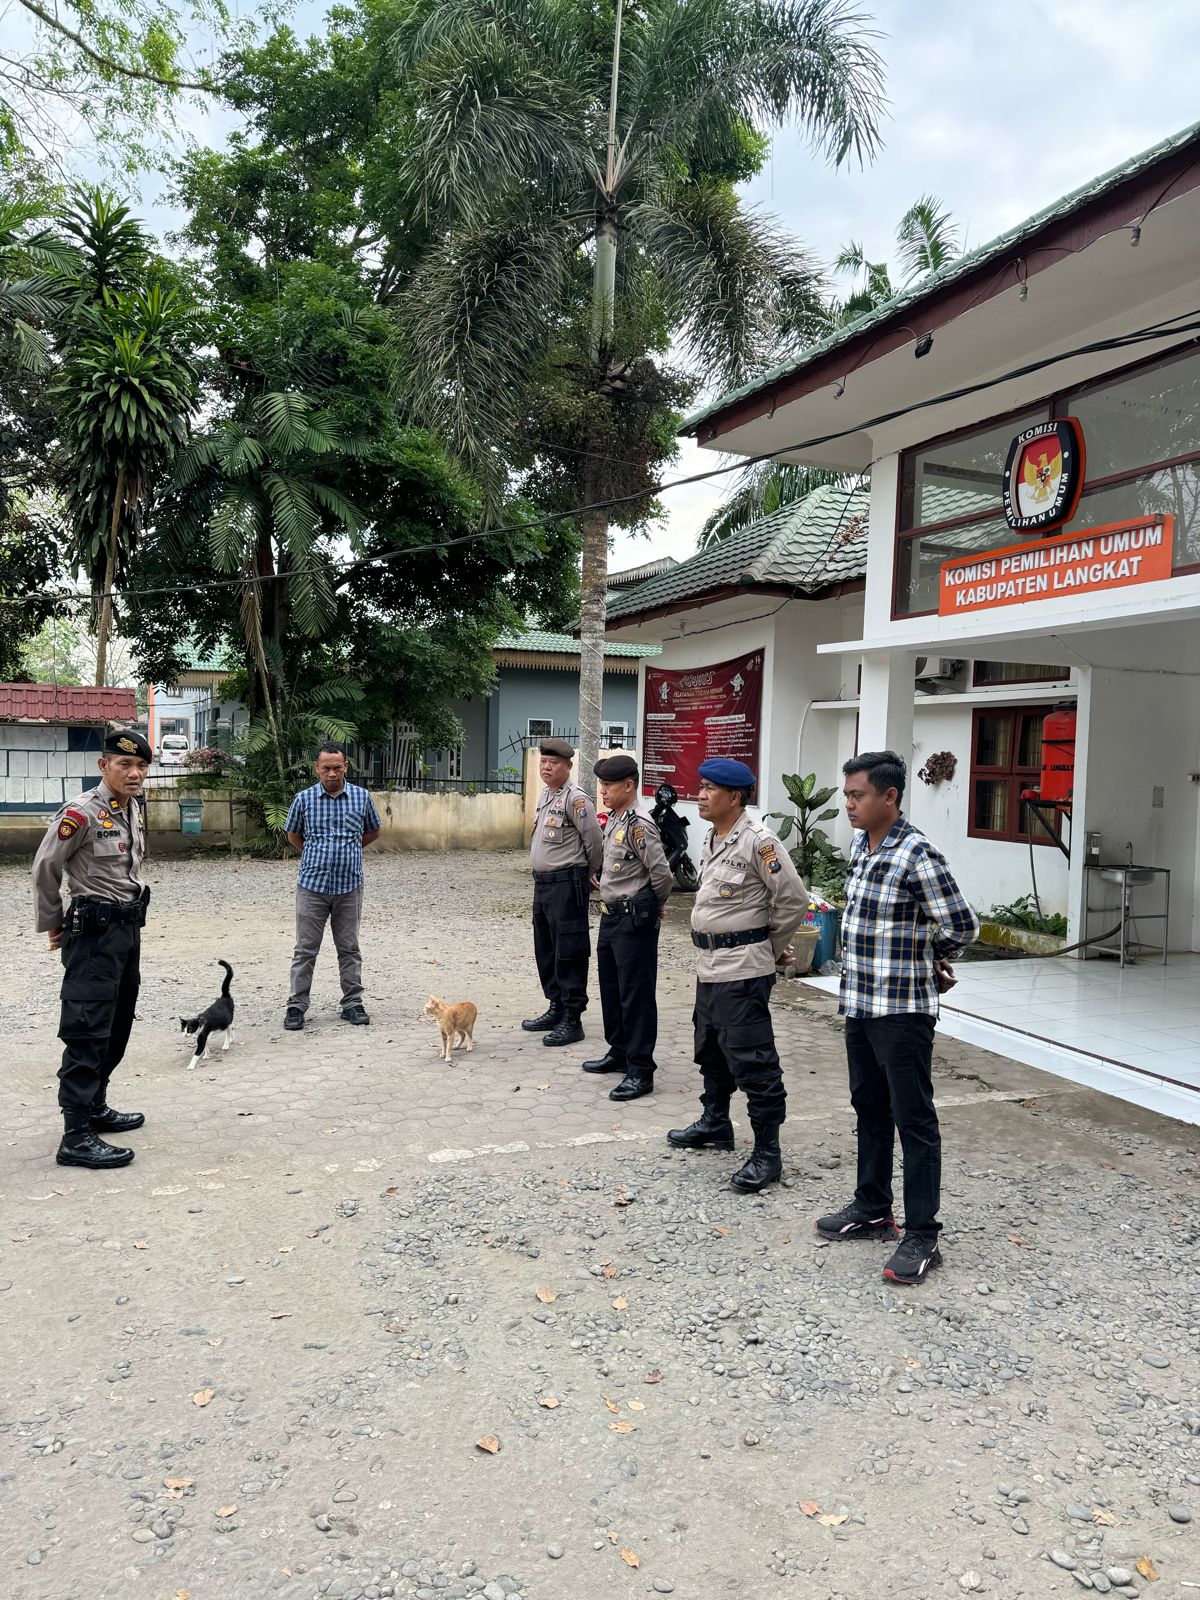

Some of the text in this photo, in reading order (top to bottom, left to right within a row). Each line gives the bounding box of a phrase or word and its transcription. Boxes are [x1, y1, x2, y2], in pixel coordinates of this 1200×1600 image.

[1018, 422, 1058, 444] KOMISI
[1003, 472, 1069, 527] PEMILIHAN UMUM
[945, 524, 1163, 587] KOMISI PEMILIHAN UMUM
[955, 556, 1142, 607] KABUPATEN LANGKAT
[720, 859, 746, 869] POLRI
